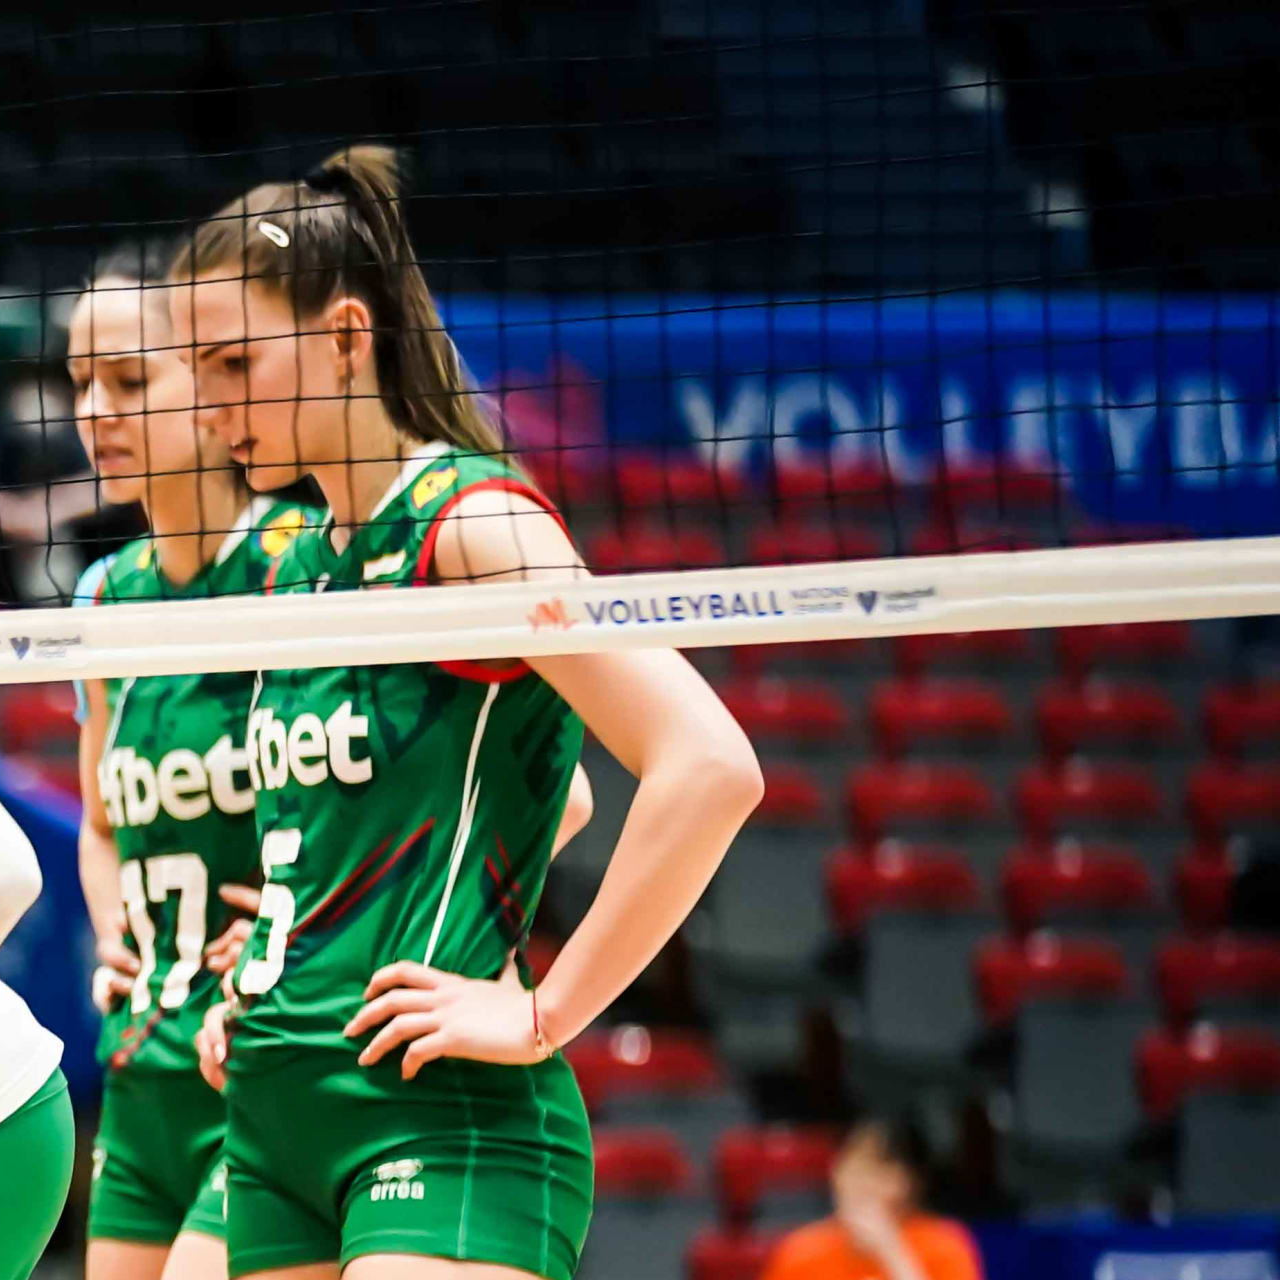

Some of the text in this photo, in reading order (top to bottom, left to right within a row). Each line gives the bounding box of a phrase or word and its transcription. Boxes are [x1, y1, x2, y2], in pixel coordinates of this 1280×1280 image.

[584, 590, 784, 625] VOLLEYBALL
[120, 852, 208, 1014] 17
[239, 828, 303, 995] 5
